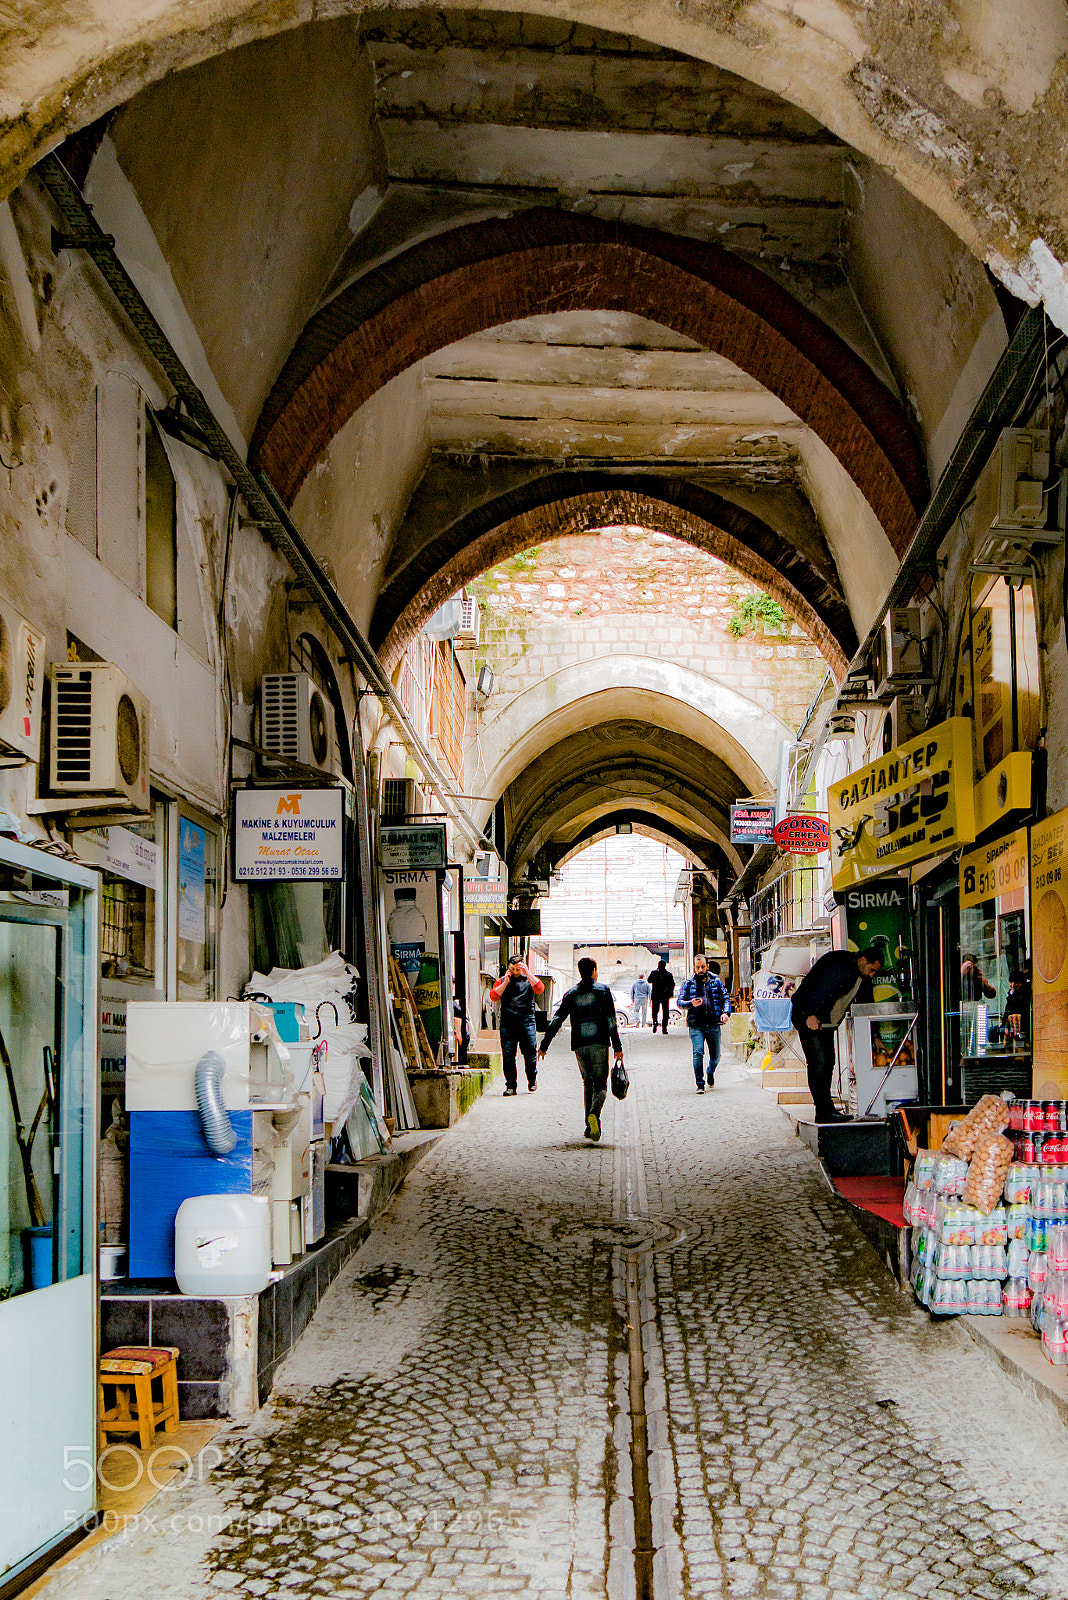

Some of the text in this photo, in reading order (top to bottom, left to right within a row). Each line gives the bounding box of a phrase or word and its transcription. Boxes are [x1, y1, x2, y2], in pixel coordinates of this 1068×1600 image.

[840, 742, 938, 810] GAZİANTEP
[276, 794, 302, 814] MT
[242, 818, 336, 828] MAKİNE & KUYUMCULUK
[262, 830, 316, 840] MALZEMELERİ
[258, 845, 291, 856] Murat
[239, 867, 254, 875] 0212
[256, 867, 267, 875] 512
[269, 867, 276, 875] 21
[278, 867, 286, 875] 93
[291, 867, 306, 875] 0536
[308, 867, 319, 875] 299
[331, 867, 338, 875] 59
[980, 856, 1026, 894] 513 09 08
[386, 871, 430, 884] SIRMA
[848, 890, 905, 908] SIRMA
[394, 948, 422, 959] SIRMA
